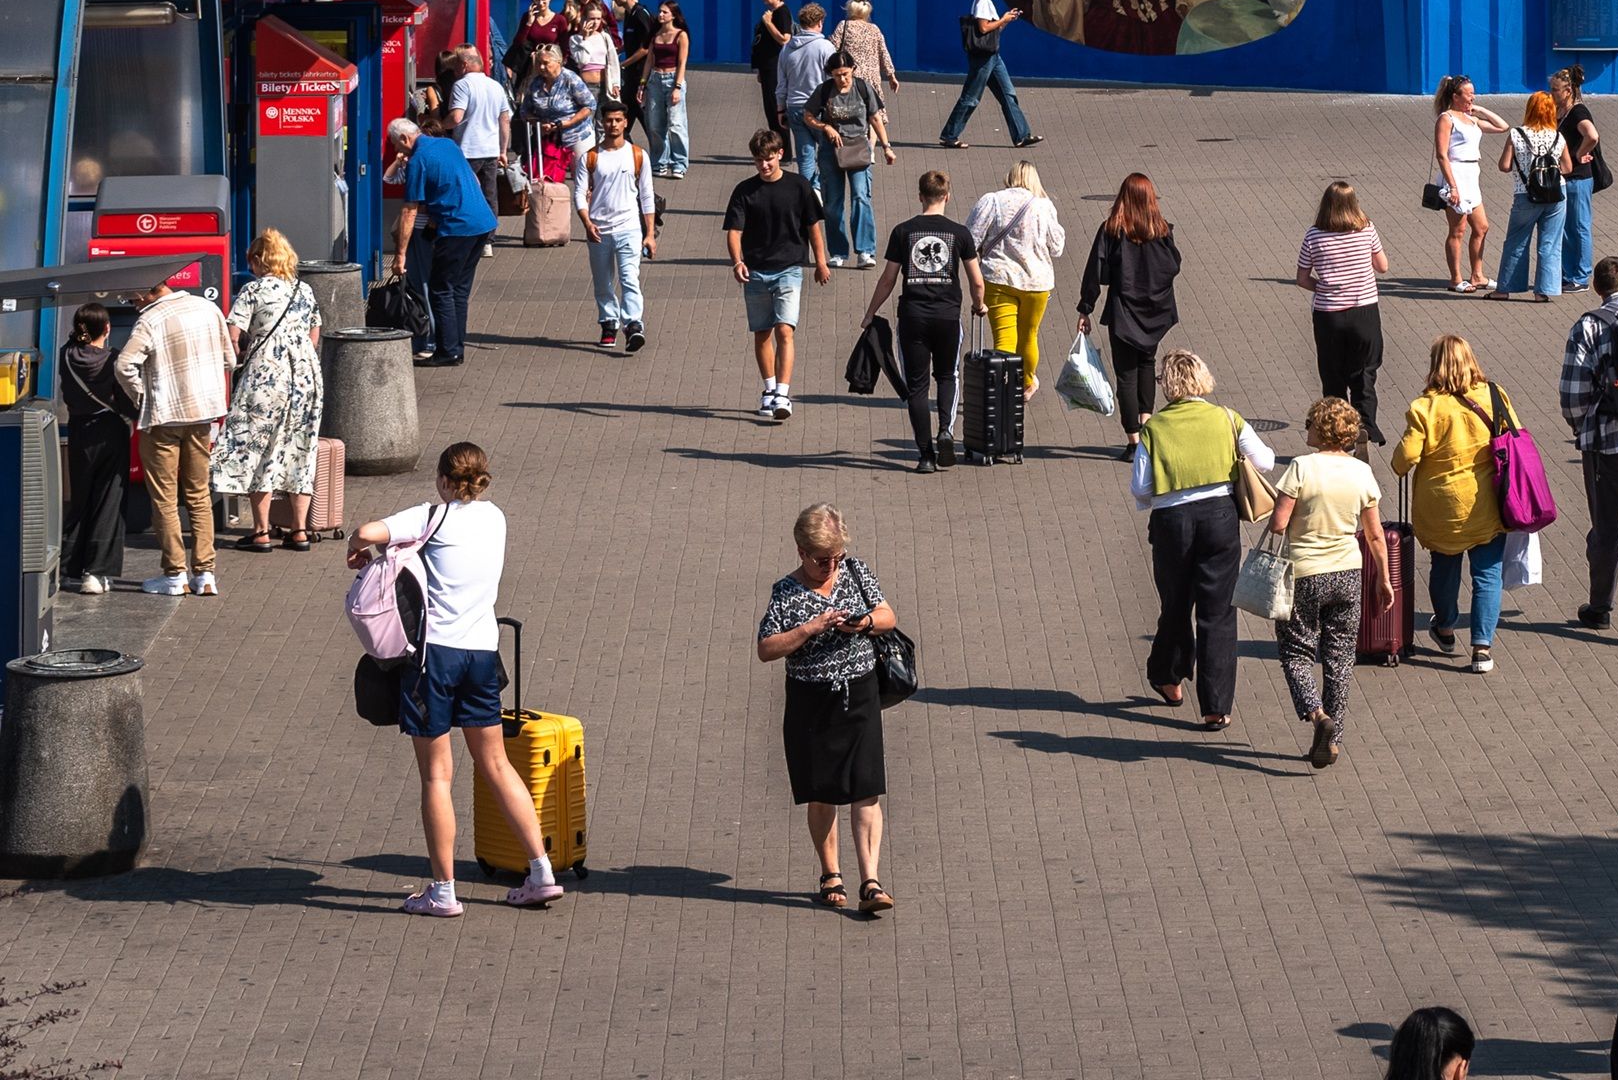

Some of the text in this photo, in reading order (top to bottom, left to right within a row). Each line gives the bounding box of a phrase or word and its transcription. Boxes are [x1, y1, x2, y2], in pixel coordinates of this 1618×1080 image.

[261, 83, 292, 94] Bilety
[300, 83, 336, 92] Tickets
[282, 107, 321, 115] MENNICA
[282, 115, 315, 123] POLSKA
